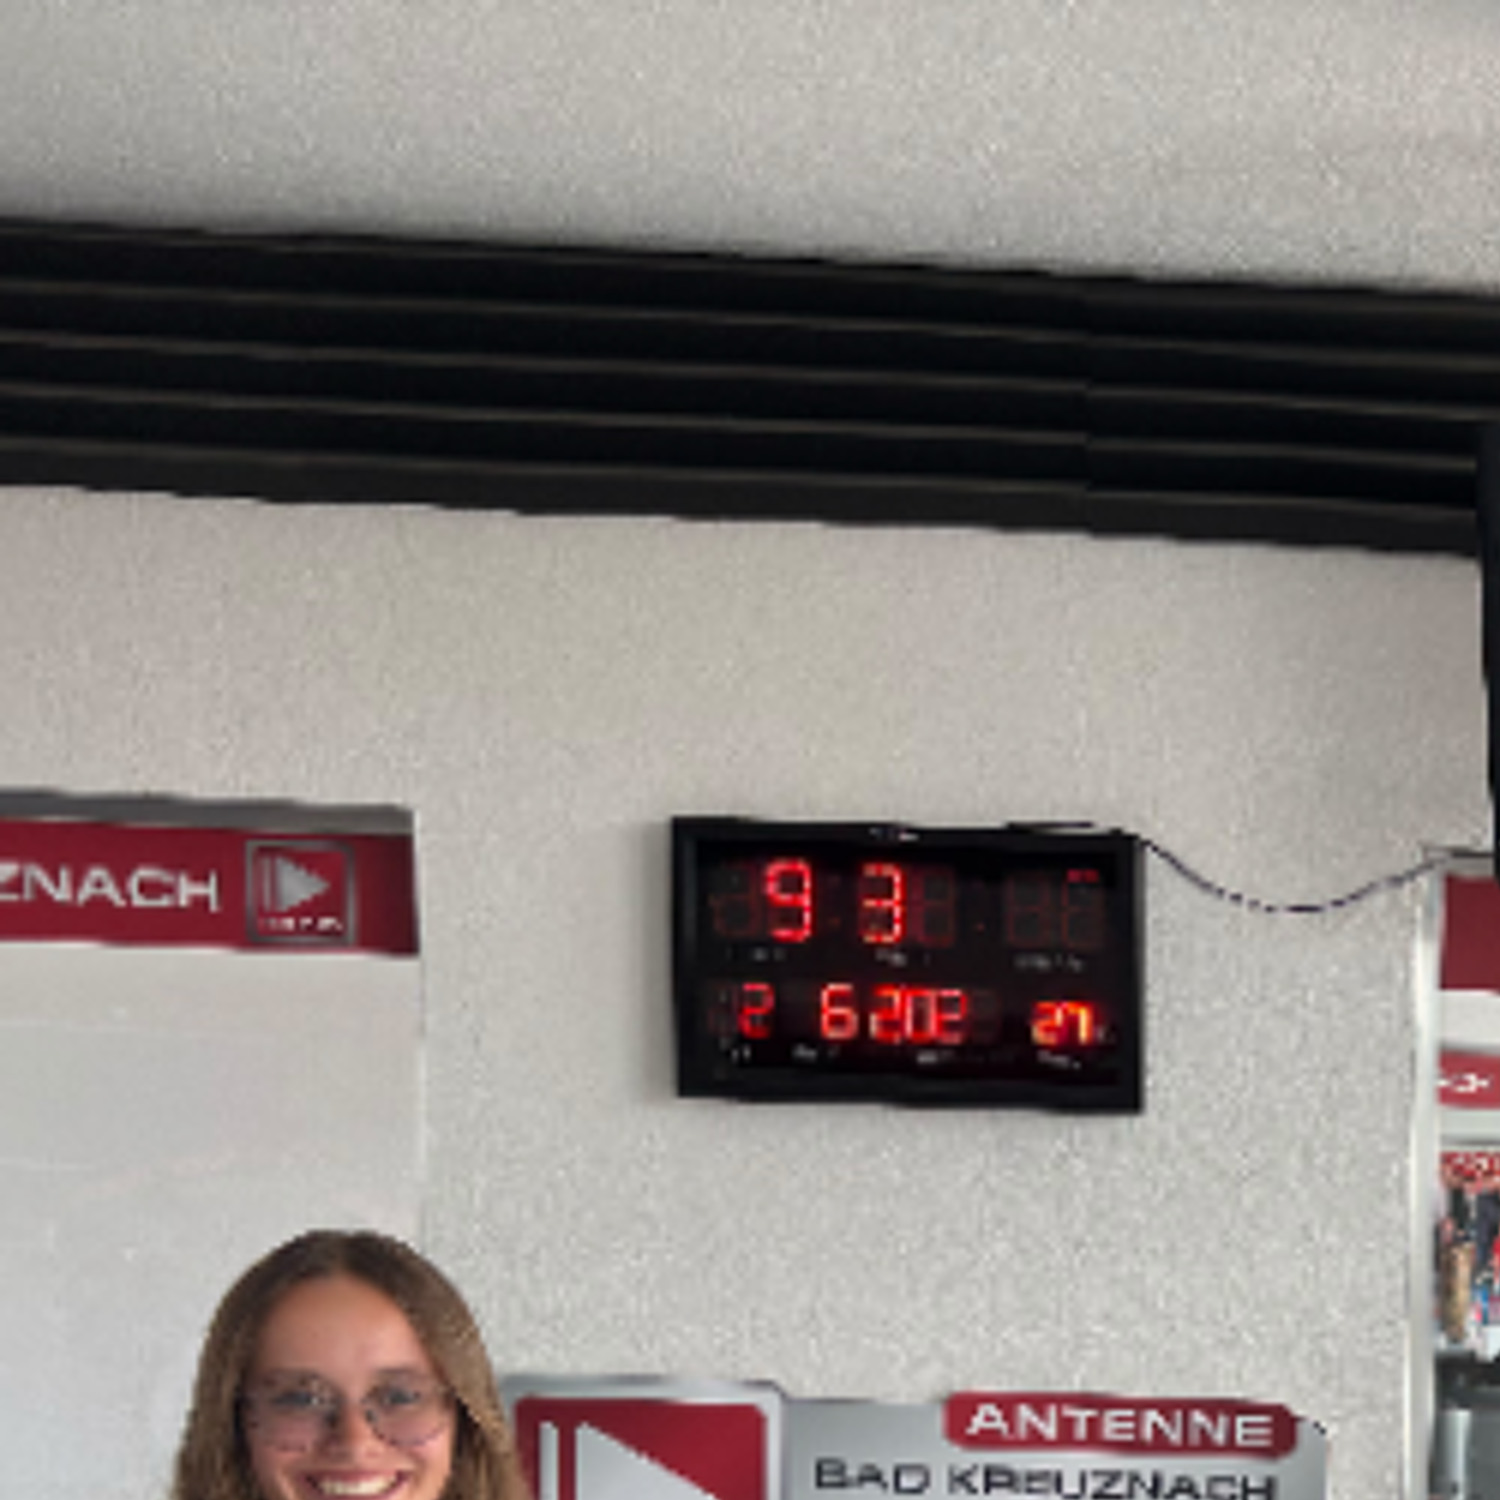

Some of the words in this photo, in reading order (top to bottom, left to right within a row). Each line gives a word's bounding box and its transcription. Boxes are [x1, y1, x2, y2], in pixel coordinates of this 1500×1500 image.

[764, 857, 812, 943] 9
[862, 862, 906, 943] 3
[820, 982, 858, 1040] 6
[965, 1401, 1274, 1447] ANTENNE
[814, 1457, 932, 1495] BAD
